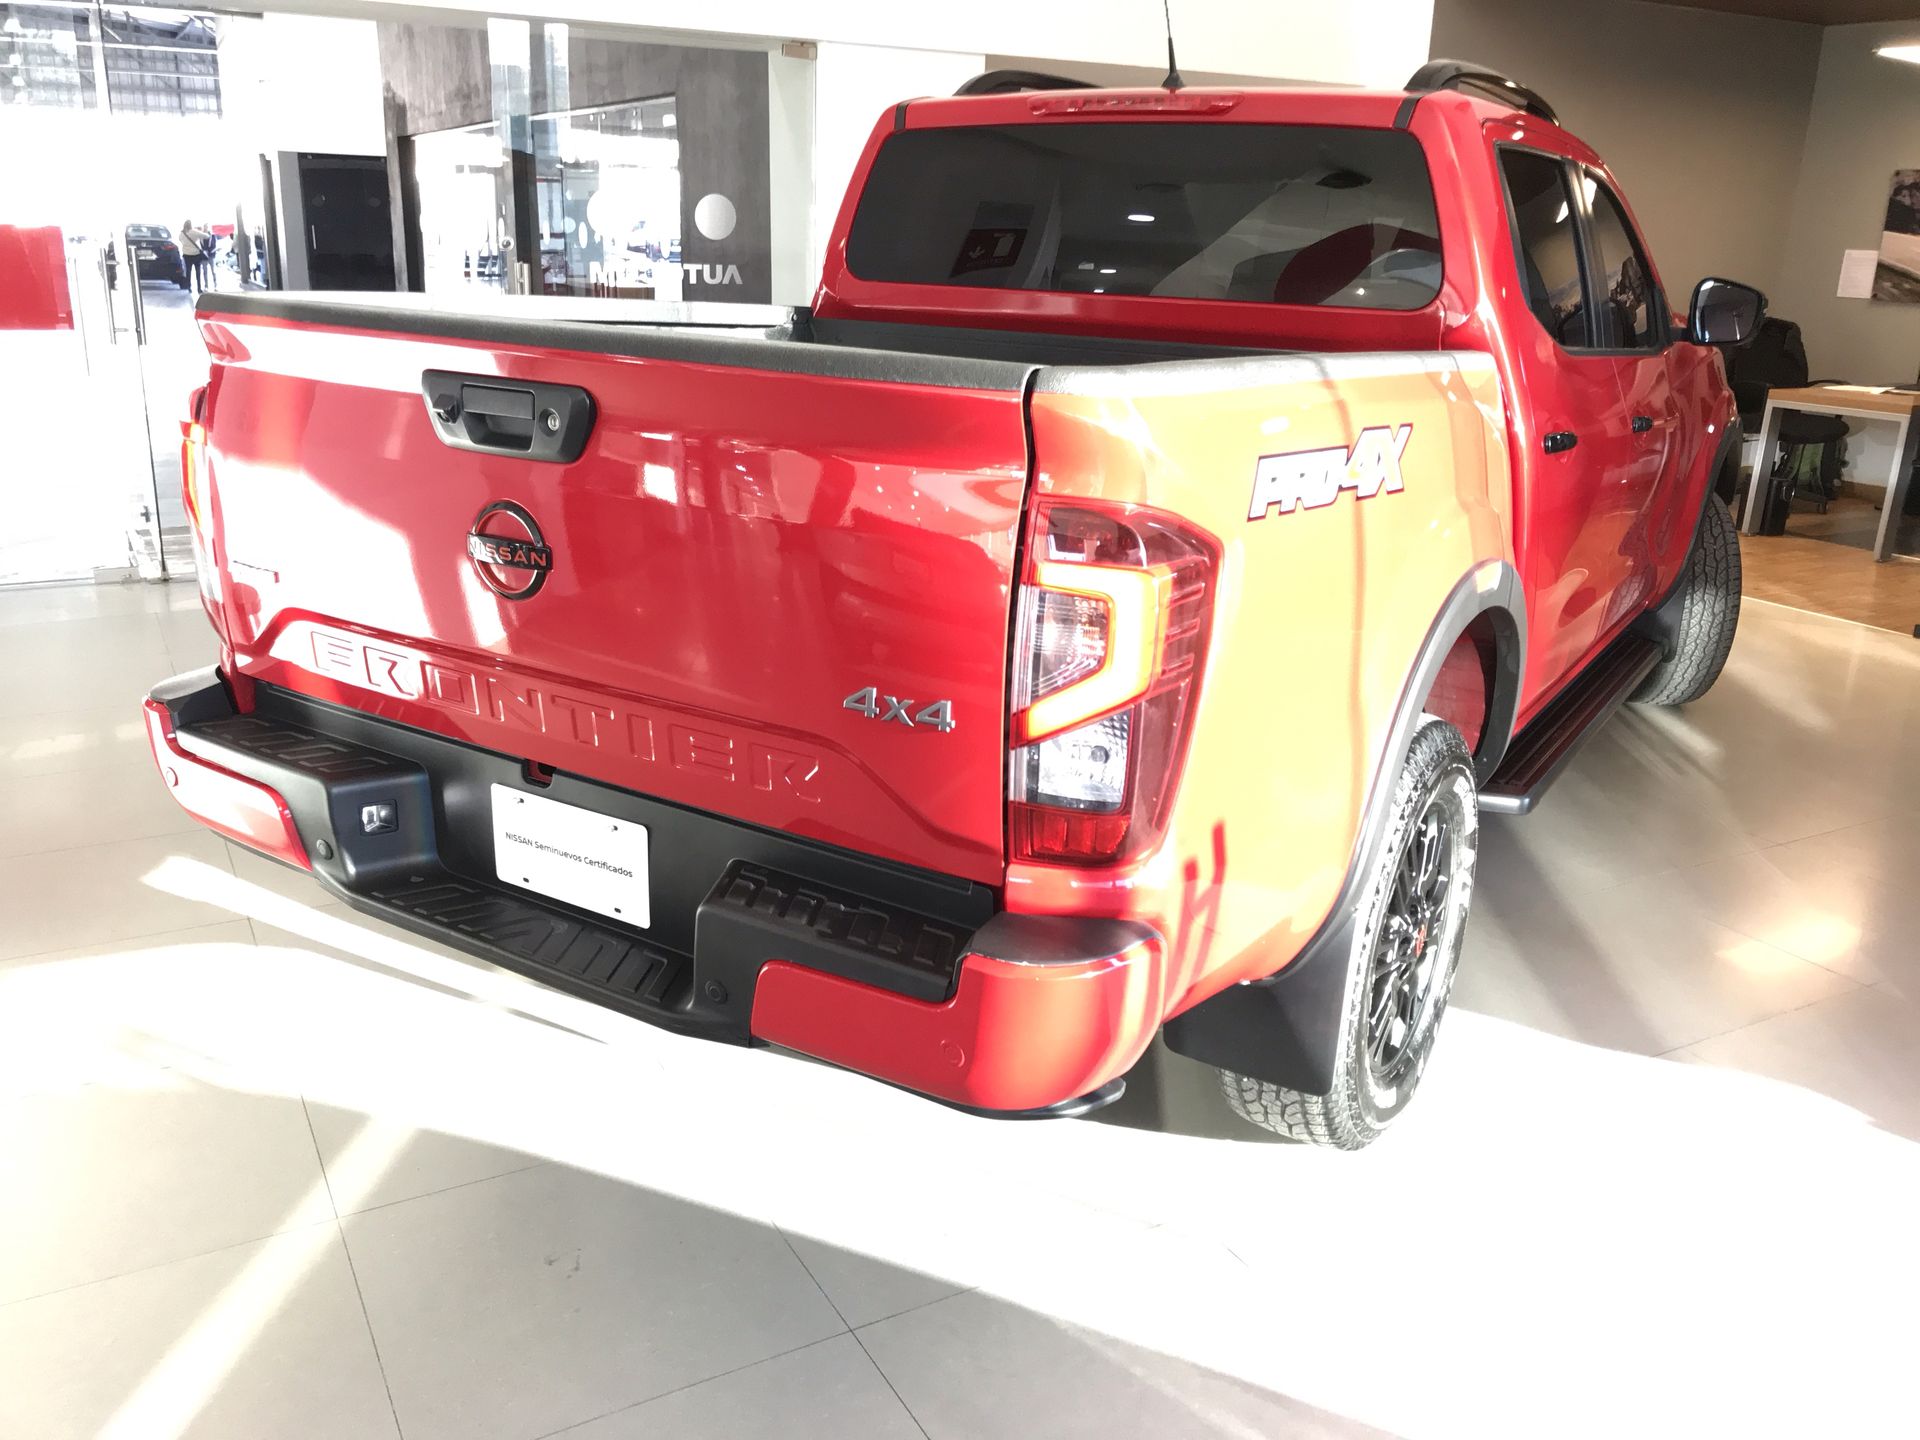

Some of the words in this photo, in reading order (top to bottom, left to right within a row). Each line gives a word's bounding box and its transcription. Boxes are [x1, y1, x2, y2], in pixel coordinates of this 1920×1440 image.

[469, 540, 547, 567] NISSAN
[309, 630, 822, 804] FRONTIER
[505, 832, 533, 847] NISSAN
[534, 841, 582, 862] Seminuevos
[584, 856, 633, 877] Certificados
